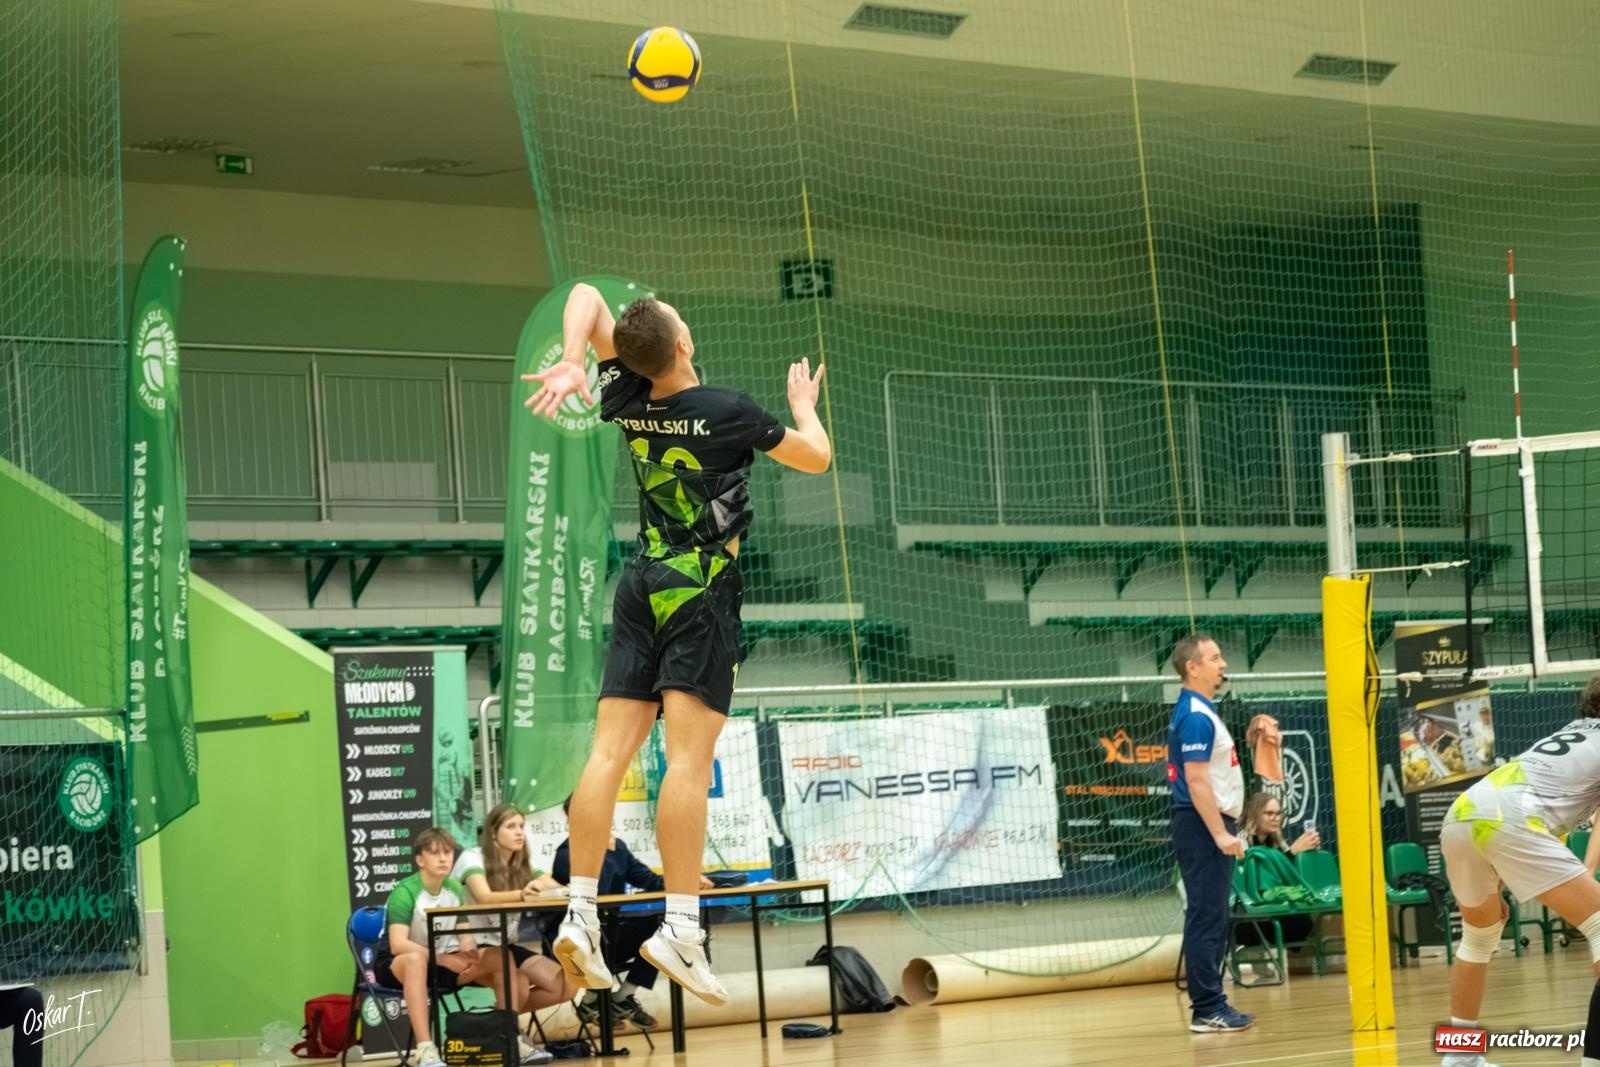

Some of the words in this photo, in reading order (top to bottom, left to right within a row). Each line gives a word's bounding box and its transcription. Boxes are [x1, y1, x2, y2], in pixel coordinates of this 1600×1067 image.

[693, 419, 711, 436] K.
[520, 451, 550, 636] SIATKARSKI
[546, 514, 569, 673] RACIBÓRZ
[343, 660, 407, 682] Szukamy
[344, 681, 405, 704] MŁODYCH
[513, 652, 536, 728] KLUB
[346, 703, 422, 719] TALENTÓW
[1533, 732, 1587, 756] 8
[365, 767, 391, 778] KADECI
[367, 789, 403, 800] JUNIORZY
[795, 768, 980, 804] VANESSA
[990, 764, 1042, 789] FM
[370, 829, 396, 840] SINGLE
[374, 879, 399, 892] CZWÓ
